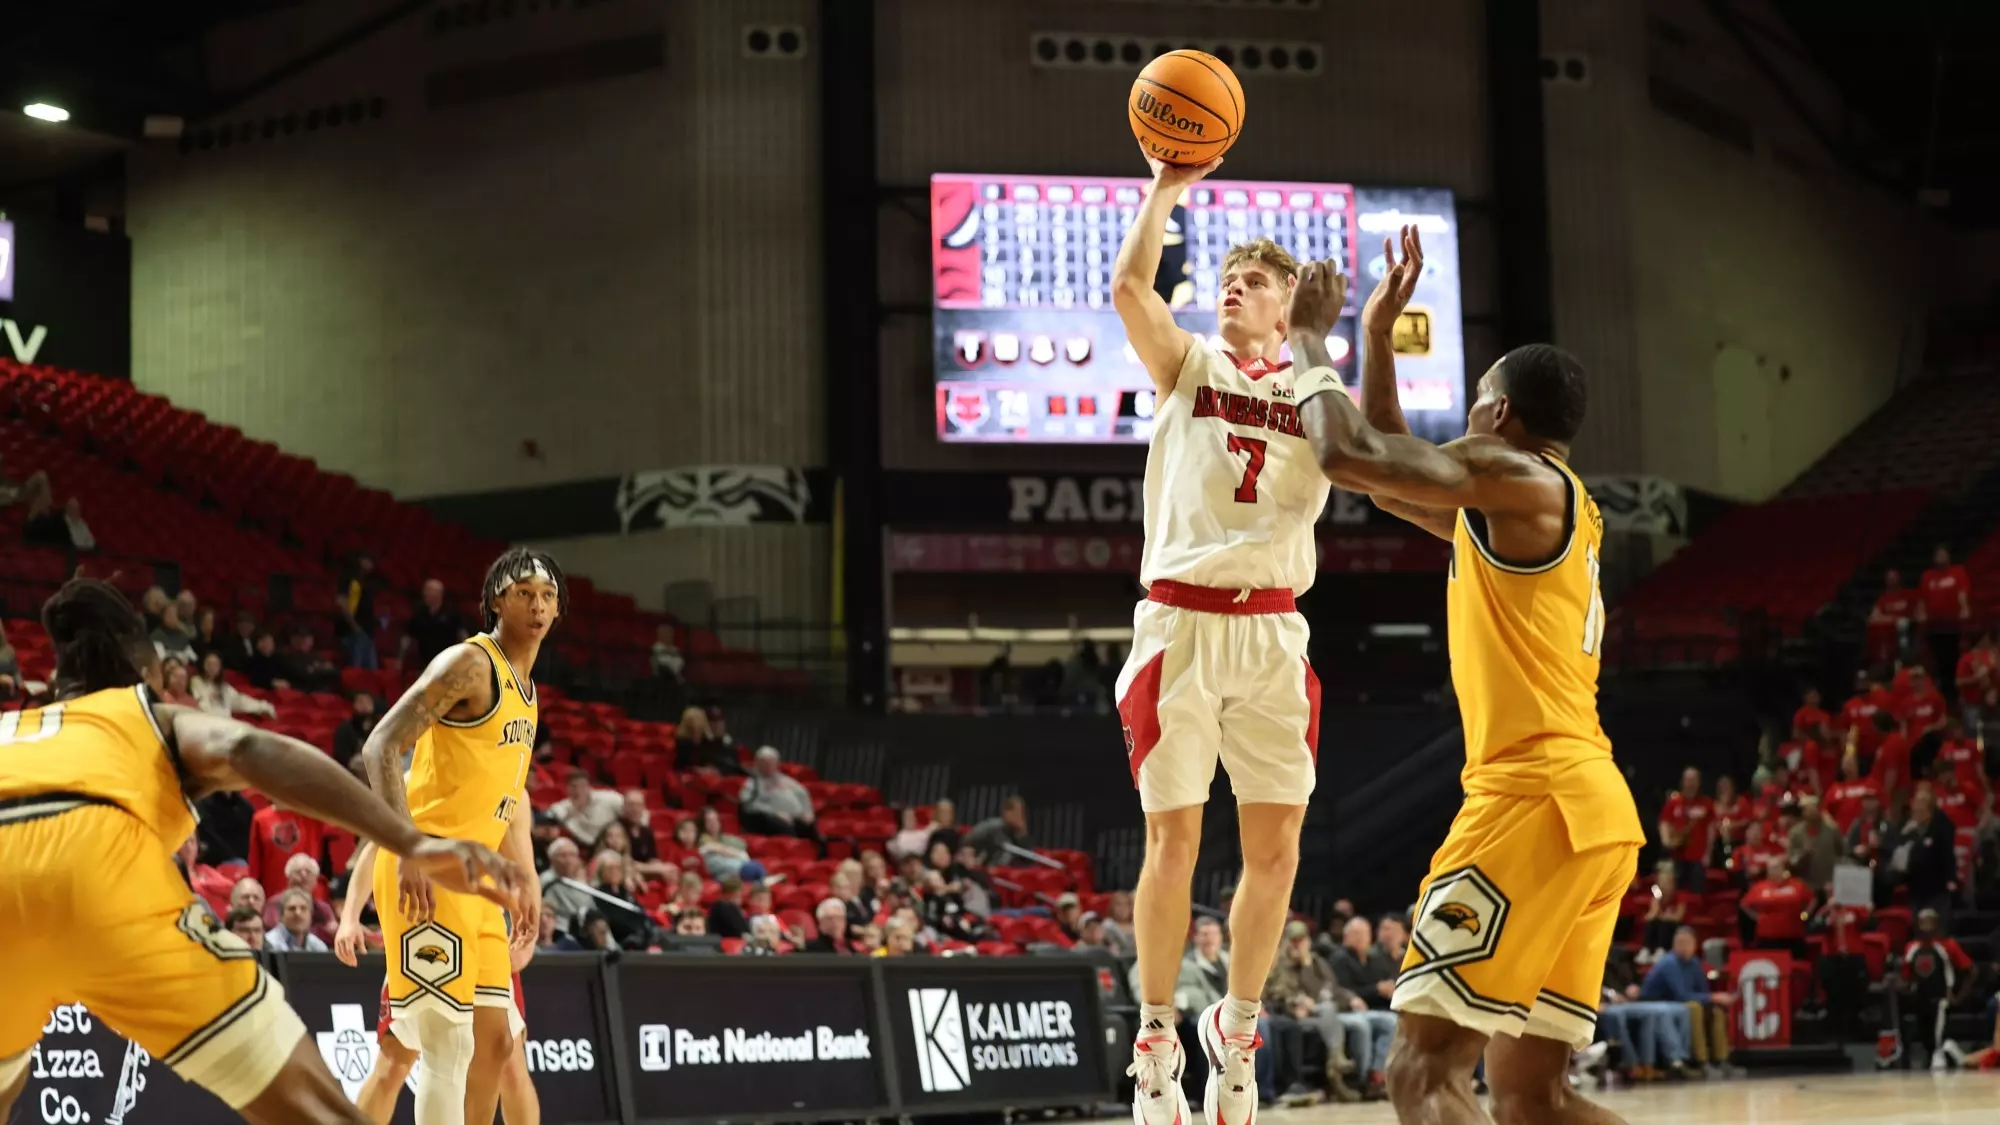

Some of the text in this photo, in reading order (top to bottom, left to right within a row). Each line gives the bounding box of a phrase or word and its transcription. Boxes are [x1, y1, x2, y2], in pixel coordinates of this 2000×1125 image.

[1137, 87, 1206, 138] Wilson
[1192, 385, 1269, 428] ARKANSAS
[1267, 401, 1309, 440] STA
[1227, 431, 1267, 504] 7
[42, 1000, 92, 1034] ost
[965, 1000, 1075, 1041] KALMER
[31, 1042, 104, 1078] izza
[525, 1038, 595, 1072] nsas
[674, 1025, 871, 1065] First National Bank
[971, 1042, 1079, 1071] SOLUTIONS
[40, 1086, 91, 1125] Co.
